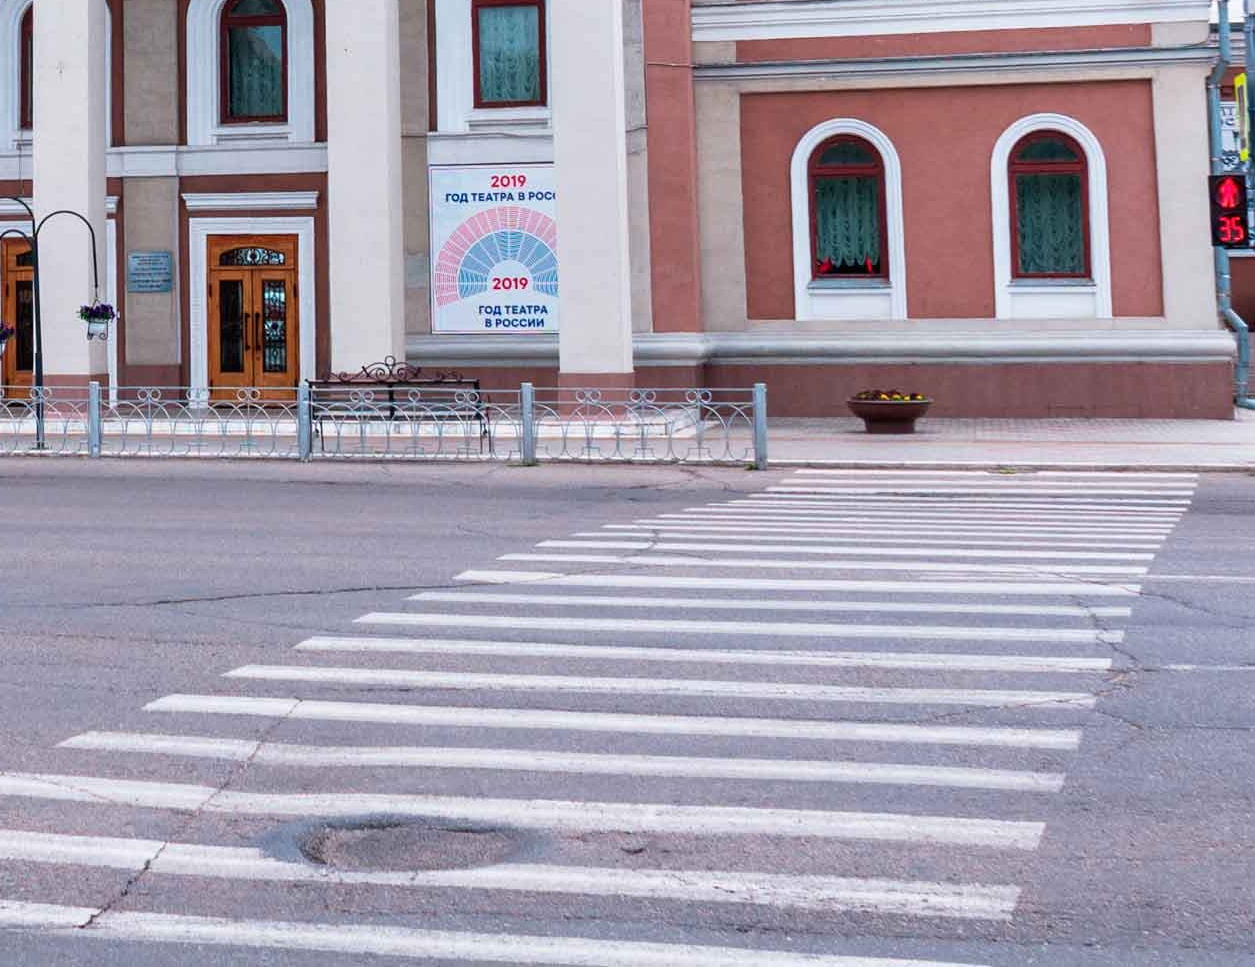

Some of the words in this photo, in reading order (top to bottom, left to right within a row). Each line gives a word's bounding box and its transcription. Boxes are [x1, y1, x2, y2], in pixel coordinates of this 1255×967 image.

[491, 175, 527, 188] 2019
[445, 193, 469, 204] ГОД
[471, 192, 514, 202] ТЕАТРА
[518, 192, 526, 201] В
[528, 191, 556, 201] РОС
[1218, 216, 1244, 242] 35
[492, 277, 529, 290] 2019
[478, 305, 502, 316] ГОД
[504, 305, 548, 314] ТЕАТРА
[485, 318, 492, 328] В
[495, 318, 545, 328] РОССИИ
